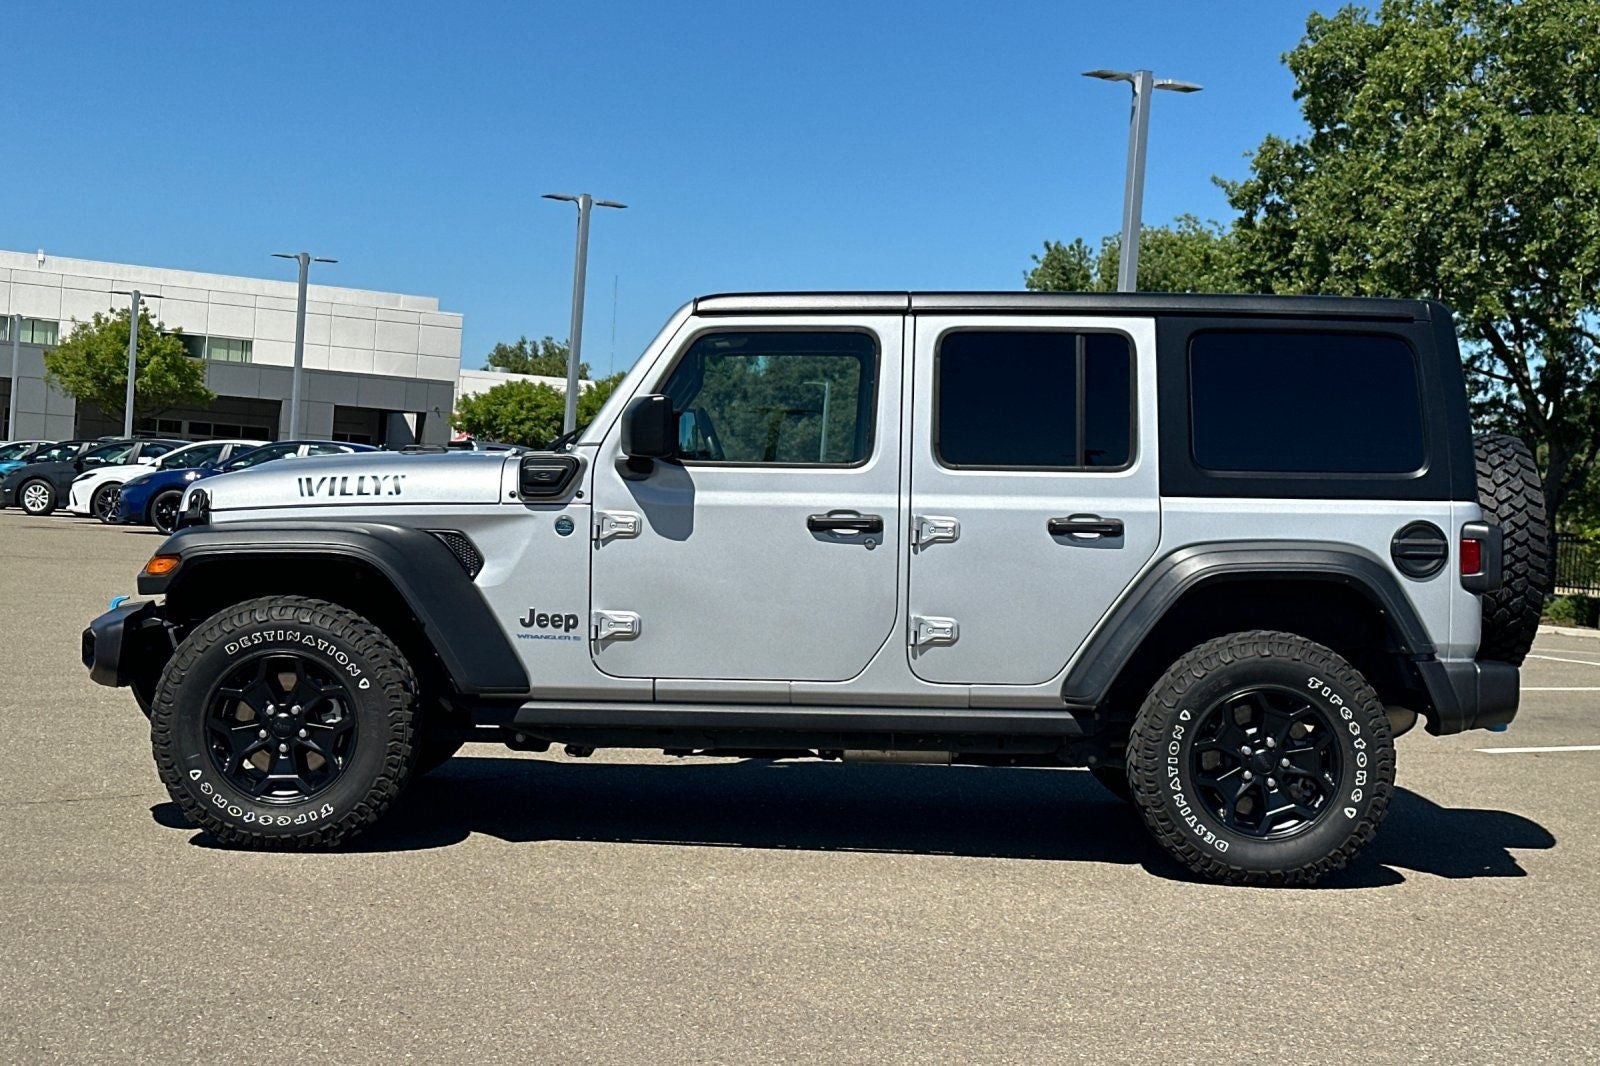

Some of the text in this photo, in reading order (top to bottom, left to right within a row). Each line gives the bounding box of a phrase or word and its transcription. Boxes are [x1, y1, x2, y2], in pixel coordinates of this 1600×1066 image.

[298, 474, 406, 497] WILLYS
[519, 606, 579, 633] Jeep
[516, 633, 571, 641] WRANGLER
[225, 630, 361, 677] DESTINATION
[1167, 724, 1229, 852] DESTINATION
